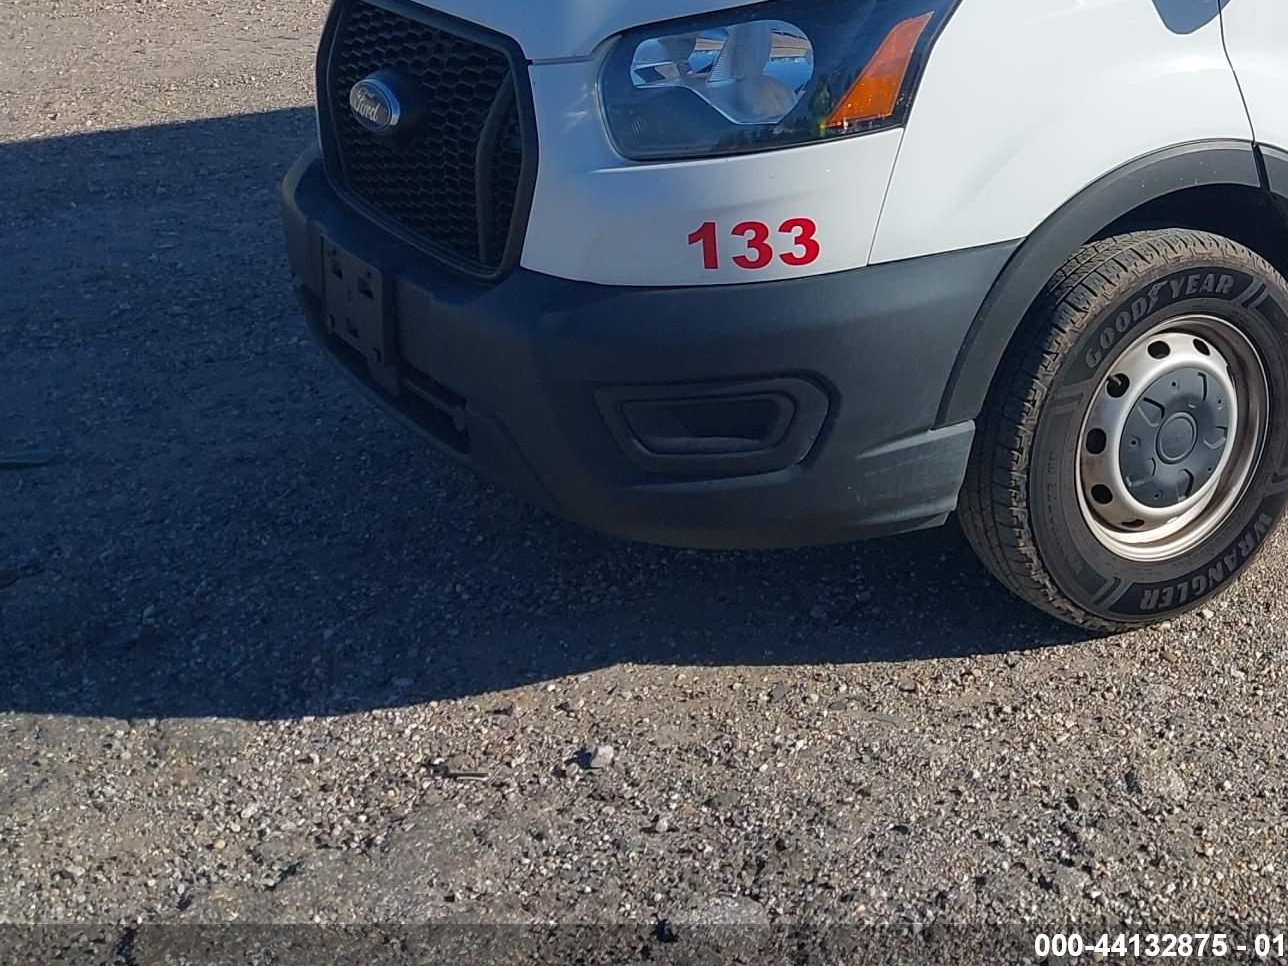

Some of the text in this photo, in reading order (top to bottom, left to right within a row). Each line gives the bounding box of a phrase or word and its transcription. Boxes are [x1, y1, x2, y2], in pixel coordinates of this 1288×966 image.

[354, 88, 381, 122] Ford
[687, 217, 820, 271] 133
[1139, 513, 1273, 611] WRANGLER
